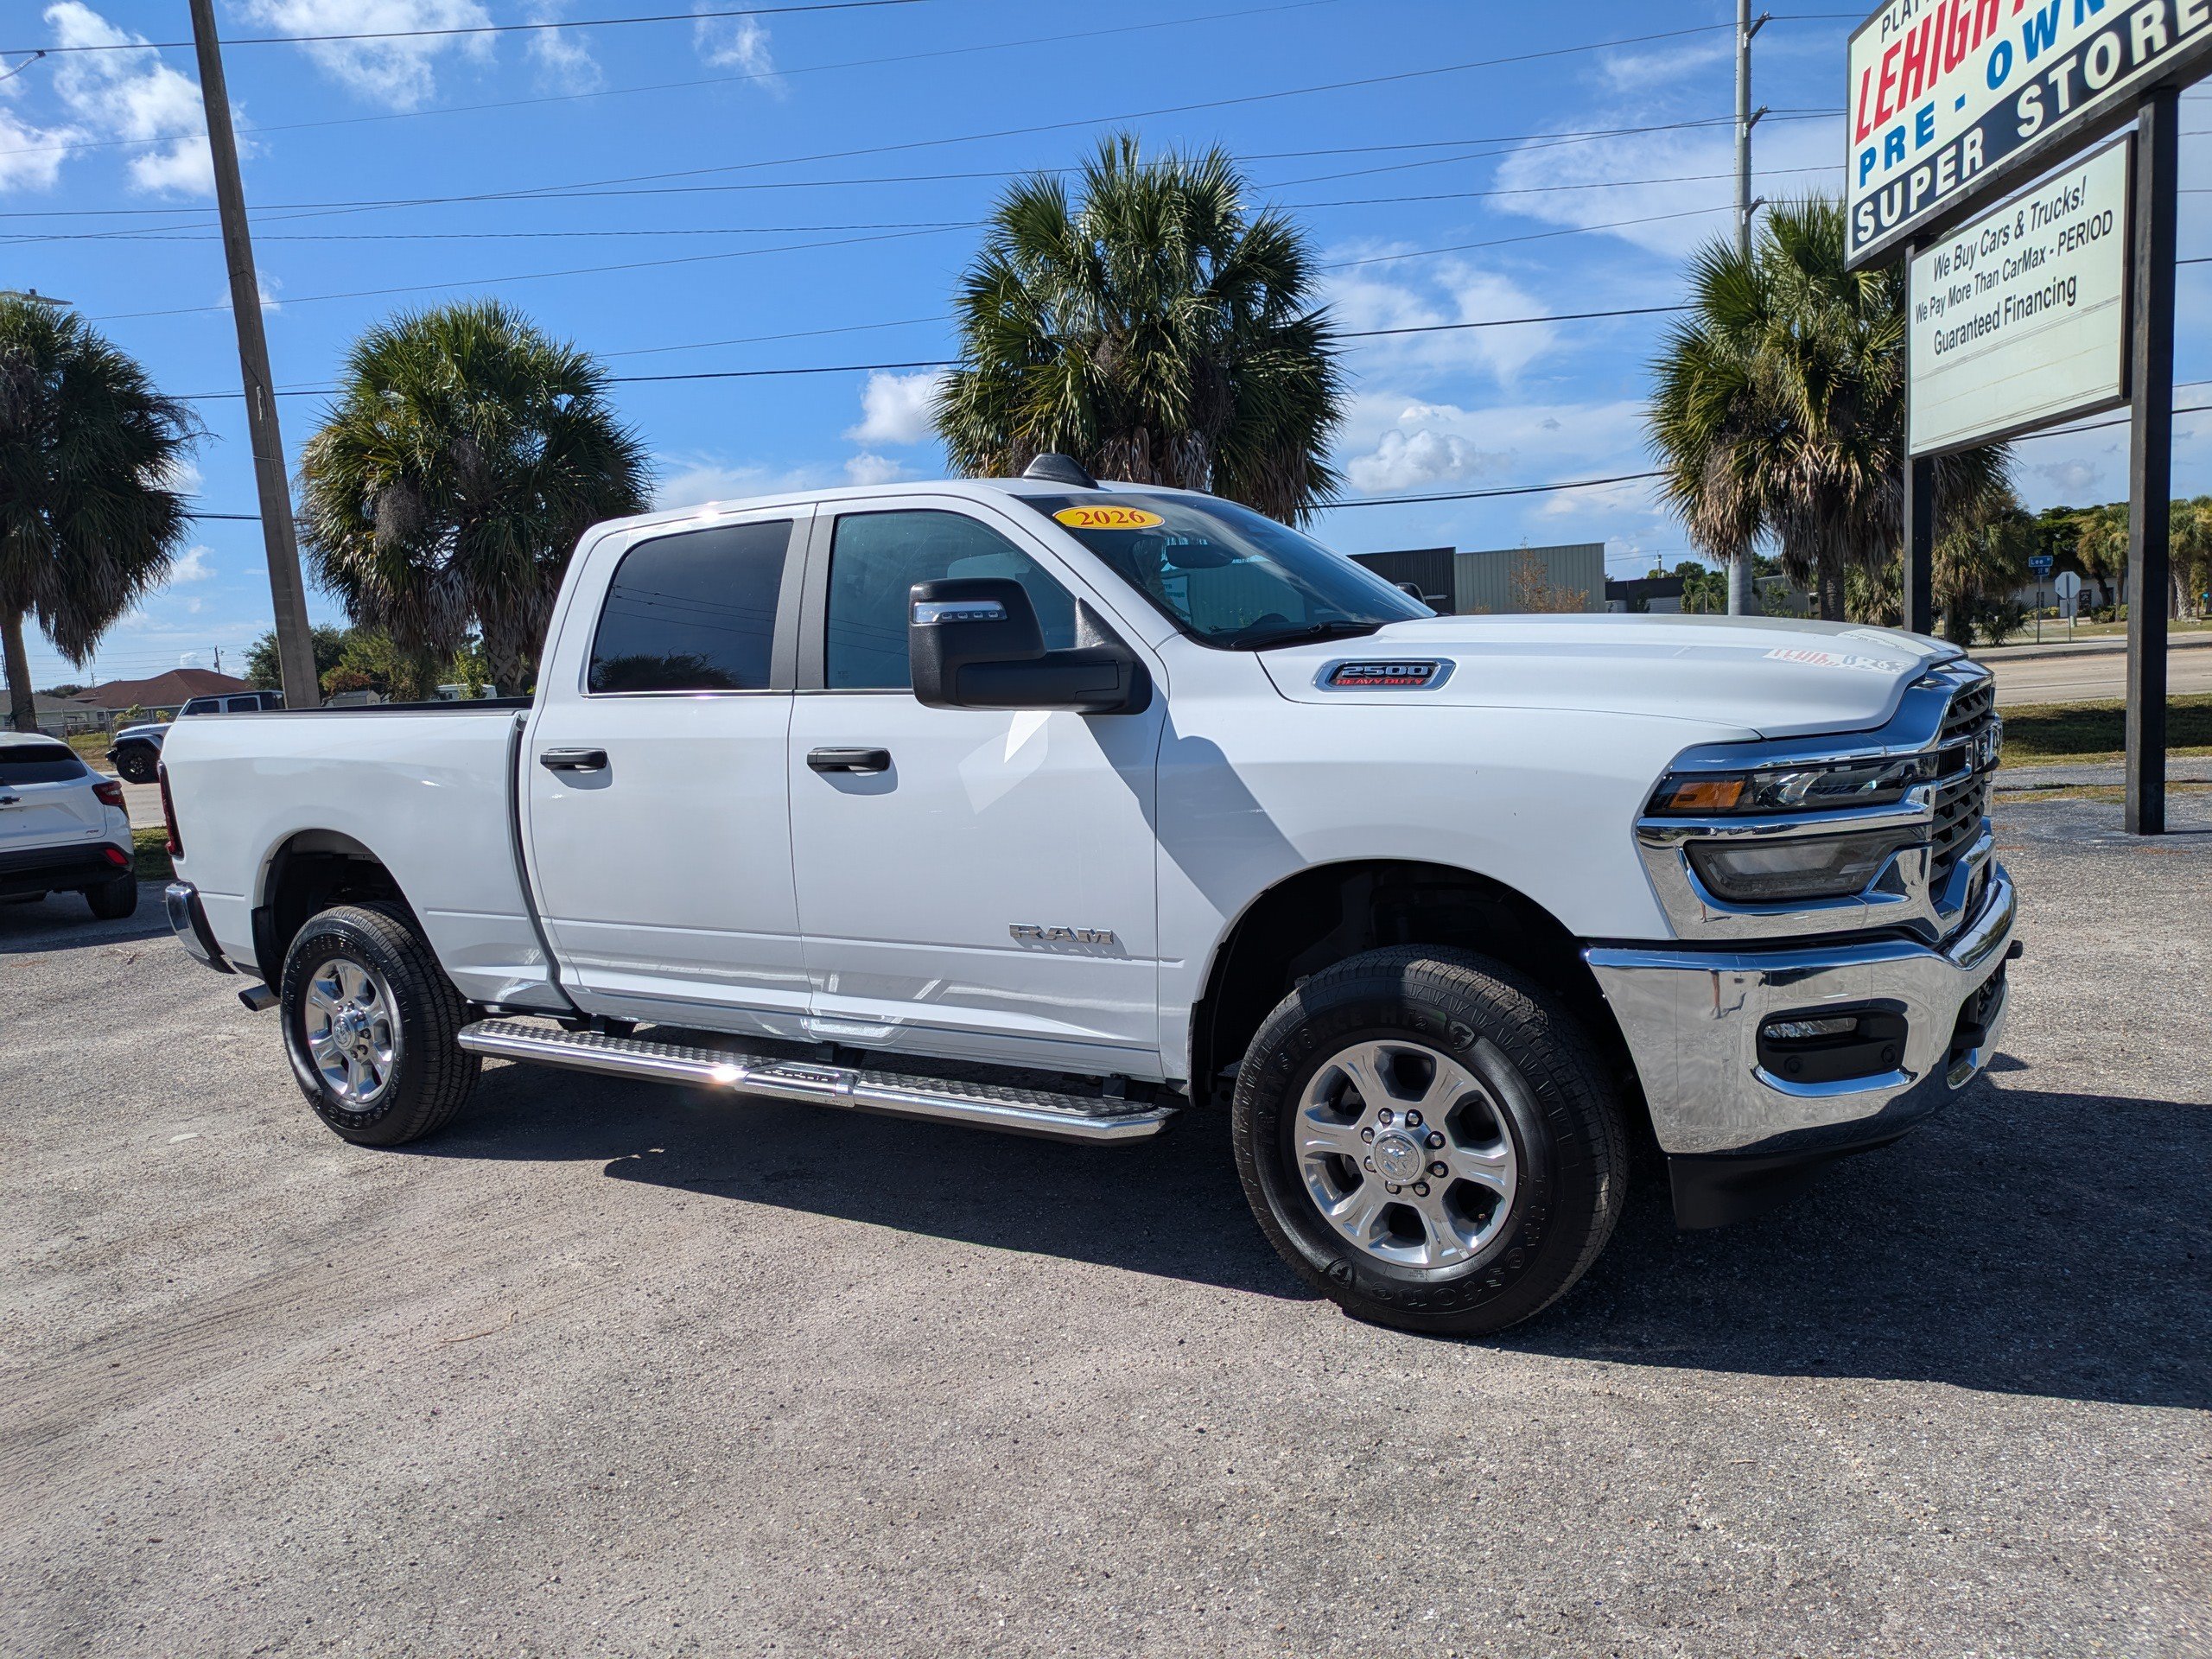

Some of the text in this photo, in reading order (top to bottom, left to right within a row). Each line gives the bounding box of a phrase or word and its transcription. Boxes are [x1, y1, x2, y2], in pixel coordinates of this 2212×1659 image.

[1855, 0, 1999, 146] LEHIGH
[1857, 0, 2210, 243] SUPER STORE
[1859, 100, 1936, 189] PRE
[1915, 303, 1928, 324] We
[1929, 295, 1946, 319] Pay
[1948, 283, 1972, 308] More
[1974, 268, 1999, 296] Than
[2002, 245, 2047, 283] CarMax
[2057, 209, 2113, 257] PERIOD
[1934, 175, 2087, 282] We Buy Cars & Trucks!
[1934, 275, 2077, 355] Guaranteed Financing
[1075, 509, 1147, 526] 2026
[1336, 677, 1384, 686] HEAVY
[1341, 664, 1429, 677] 2500
[1009, 922, 1115, 944] RAM
